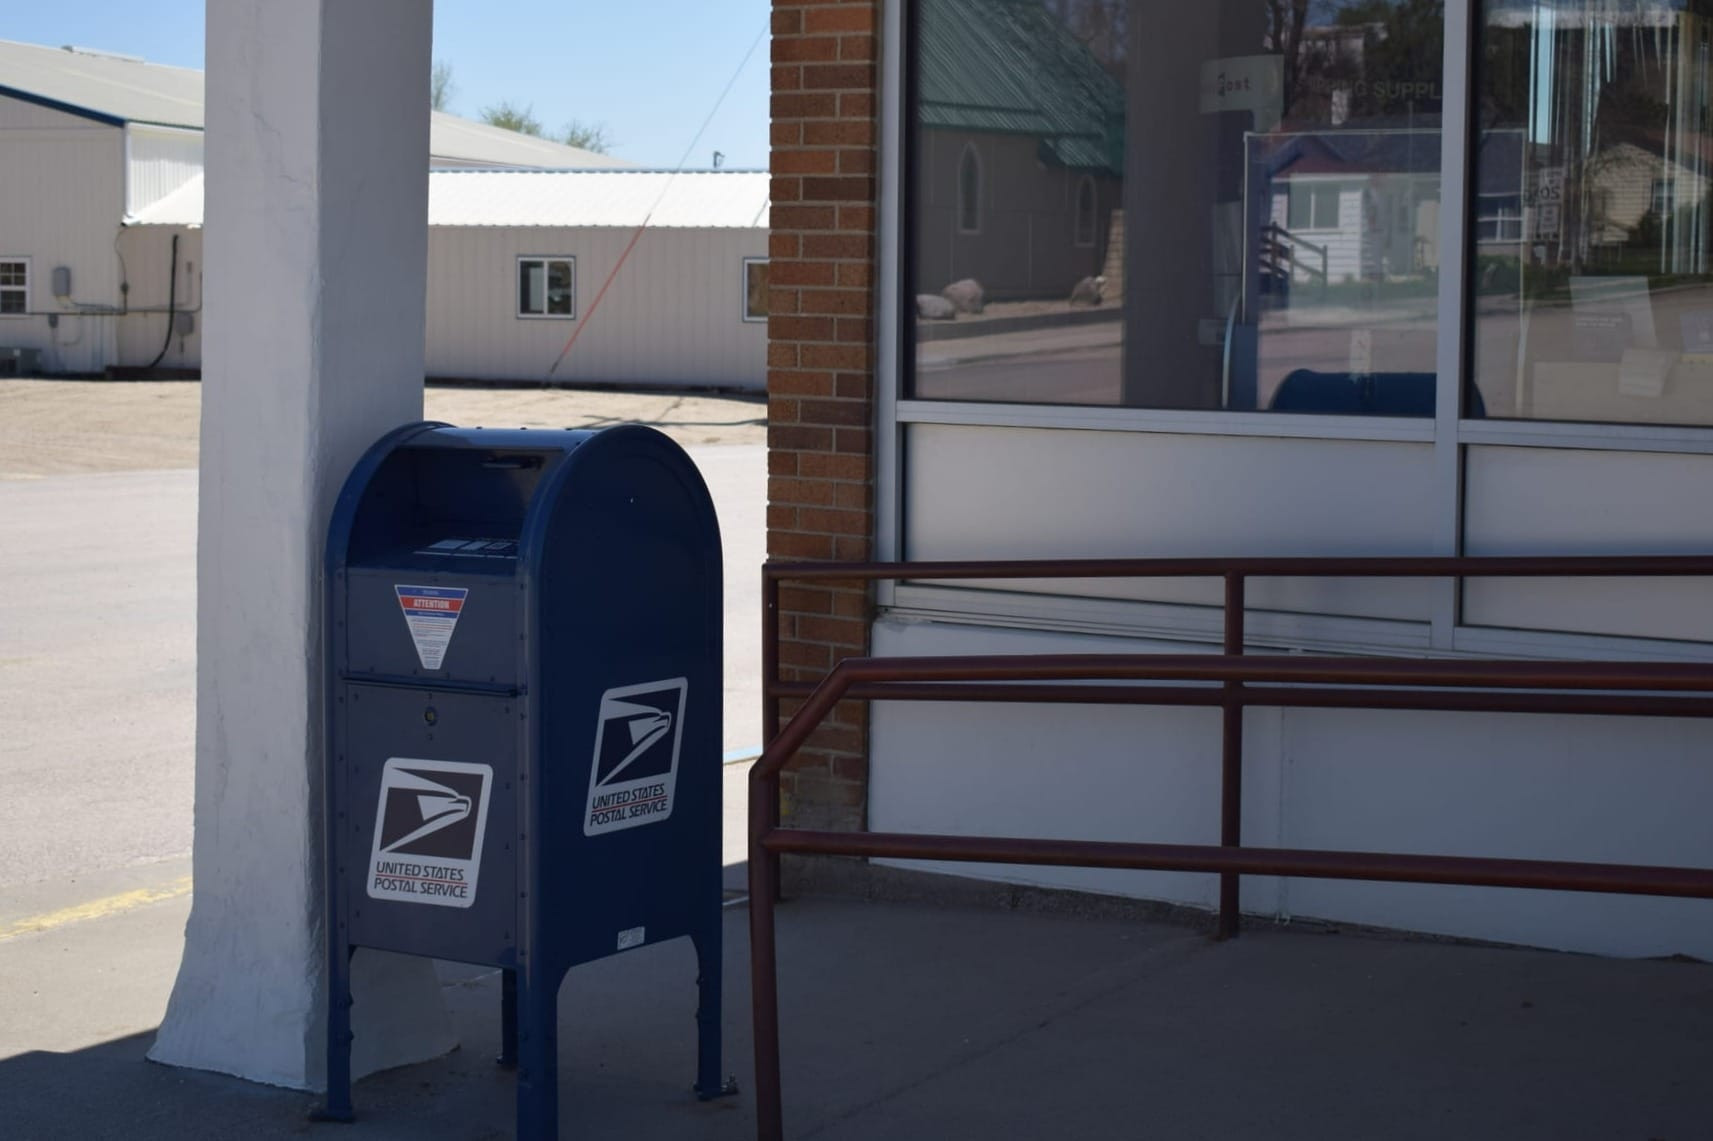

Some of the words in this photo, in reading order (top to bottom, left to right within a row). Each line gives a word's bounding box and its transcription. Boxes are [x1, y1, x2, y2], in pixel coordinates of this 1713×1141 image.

[413, 598, 450, 609] ATTENTION
[591, 790, 630, 809] UNITED
[631, 783, 665, 799] STATES
[590, 808, 627, 827] POSTAL
[629, 799, 668, 818] SERVICE
[376, 861, 421, 877] UNITED
[422, 865, 465, 881] STATES
[374, 878, 418, 894] POSTAL
[420, 881, 468, 898] SERVICE
